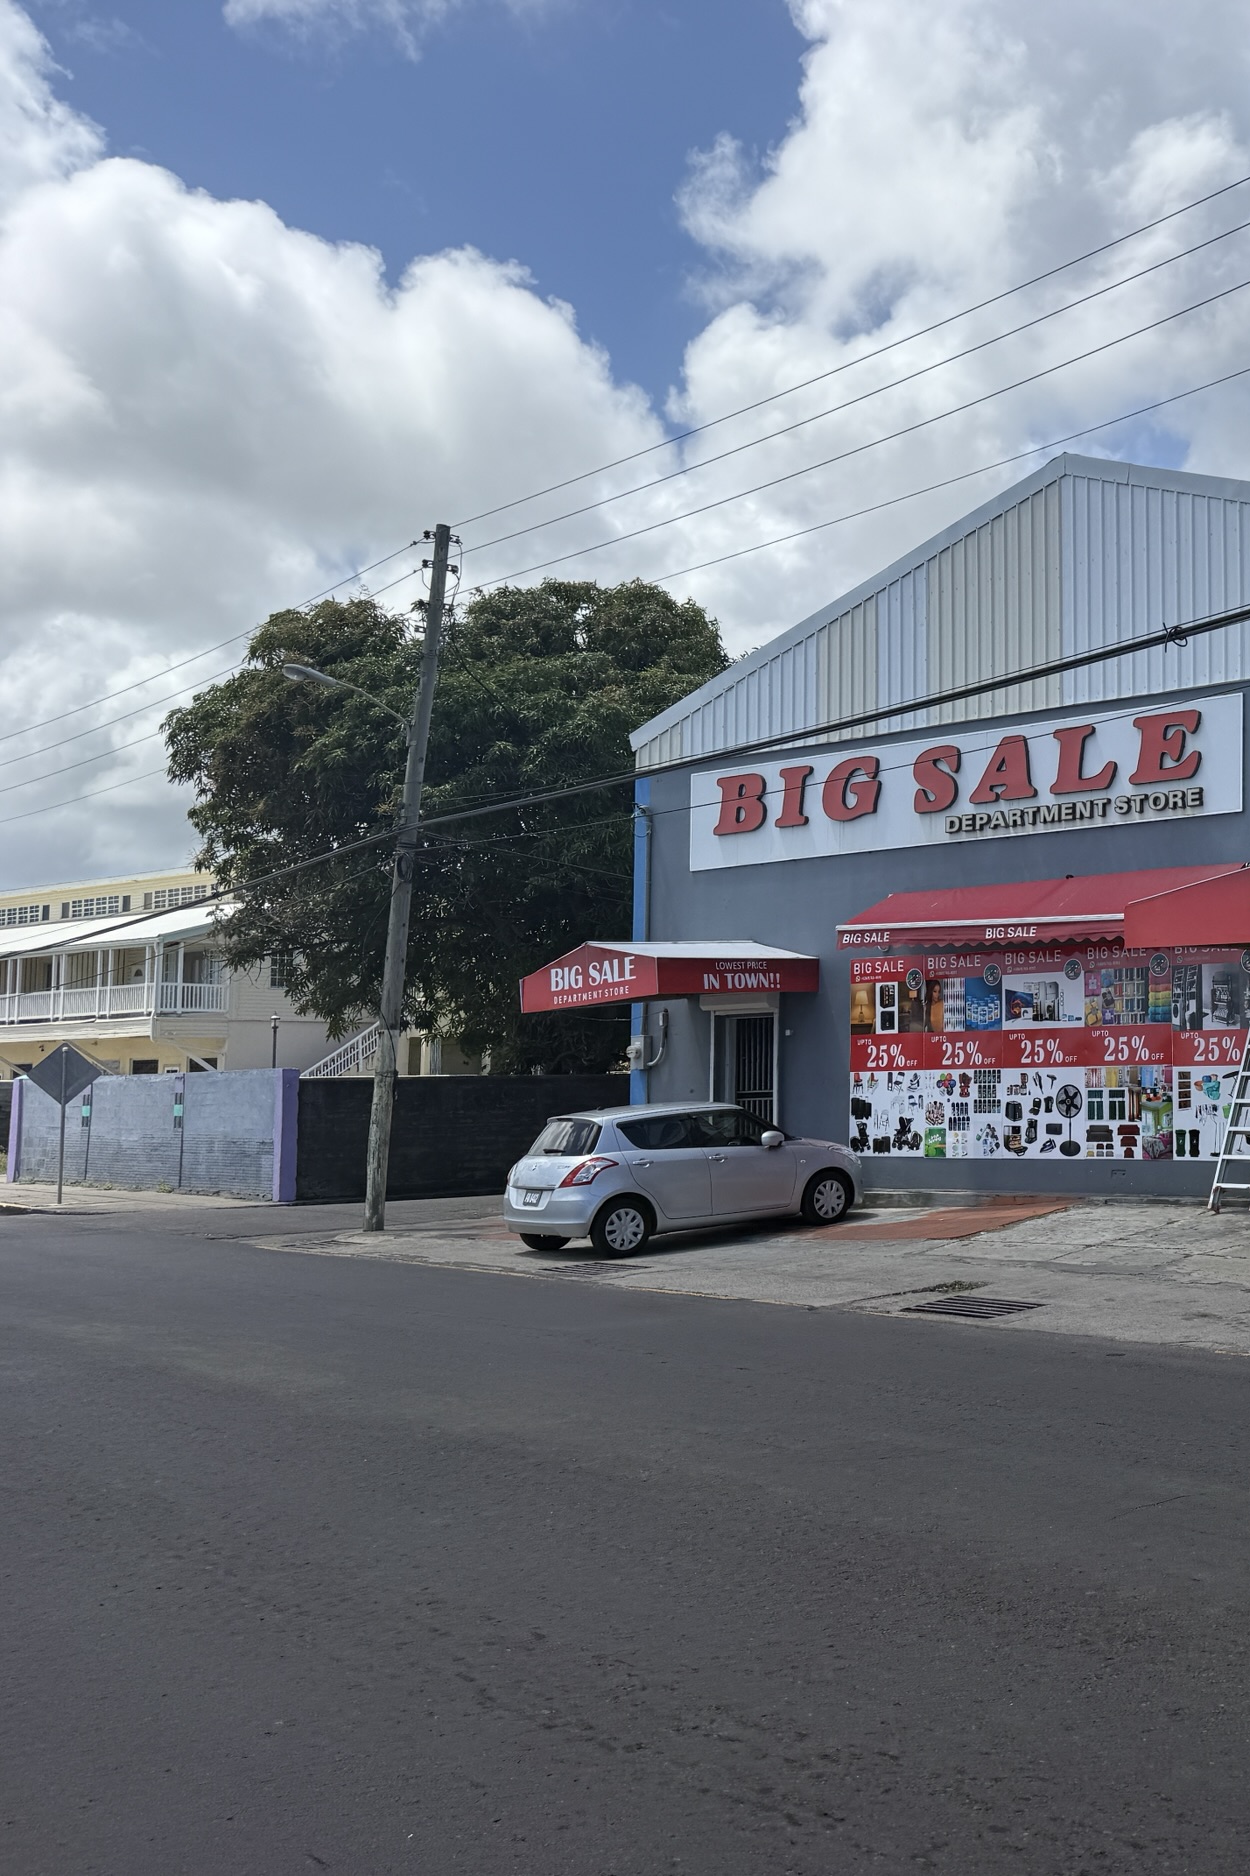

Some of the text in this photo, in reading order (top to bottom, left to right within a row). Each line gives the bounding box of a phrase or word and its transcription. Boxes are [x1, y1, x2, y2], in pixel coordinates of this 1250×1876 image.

[713, 709, 1202, 835] BIG SALE
[945, 787, 1203, 833] DEPARTMENT STORE
[842, 931, 890, 944] BIG SALE
[985, 926, 1037, 939] BIG SALE
[927, 955, 981, 969] BIG SALE
[1005, 950, 1061, 965] BIG SALE
[1087, 946, 1147, 959] BIG SALE
[551, 956, 637, 991] BIG SALE
[715, 961, 767, 970] LOWEST PRICE
[853, 960, 904, 975] BIG SALE
[703, 972, 780, 990] IN TOWN!!
[553, 985, 629, 1004] DEPARTMENT STORE
[867, 1044, 918, 1067] 25% OFF
[942, 1041, 996, 1066] 25% OFF
[1020, 1038, 1078, 1064] 25% OFF
[1103, 1035, 1164, 1062] 25% OFF
[1193, 1036, 1240, 1062] 25%
